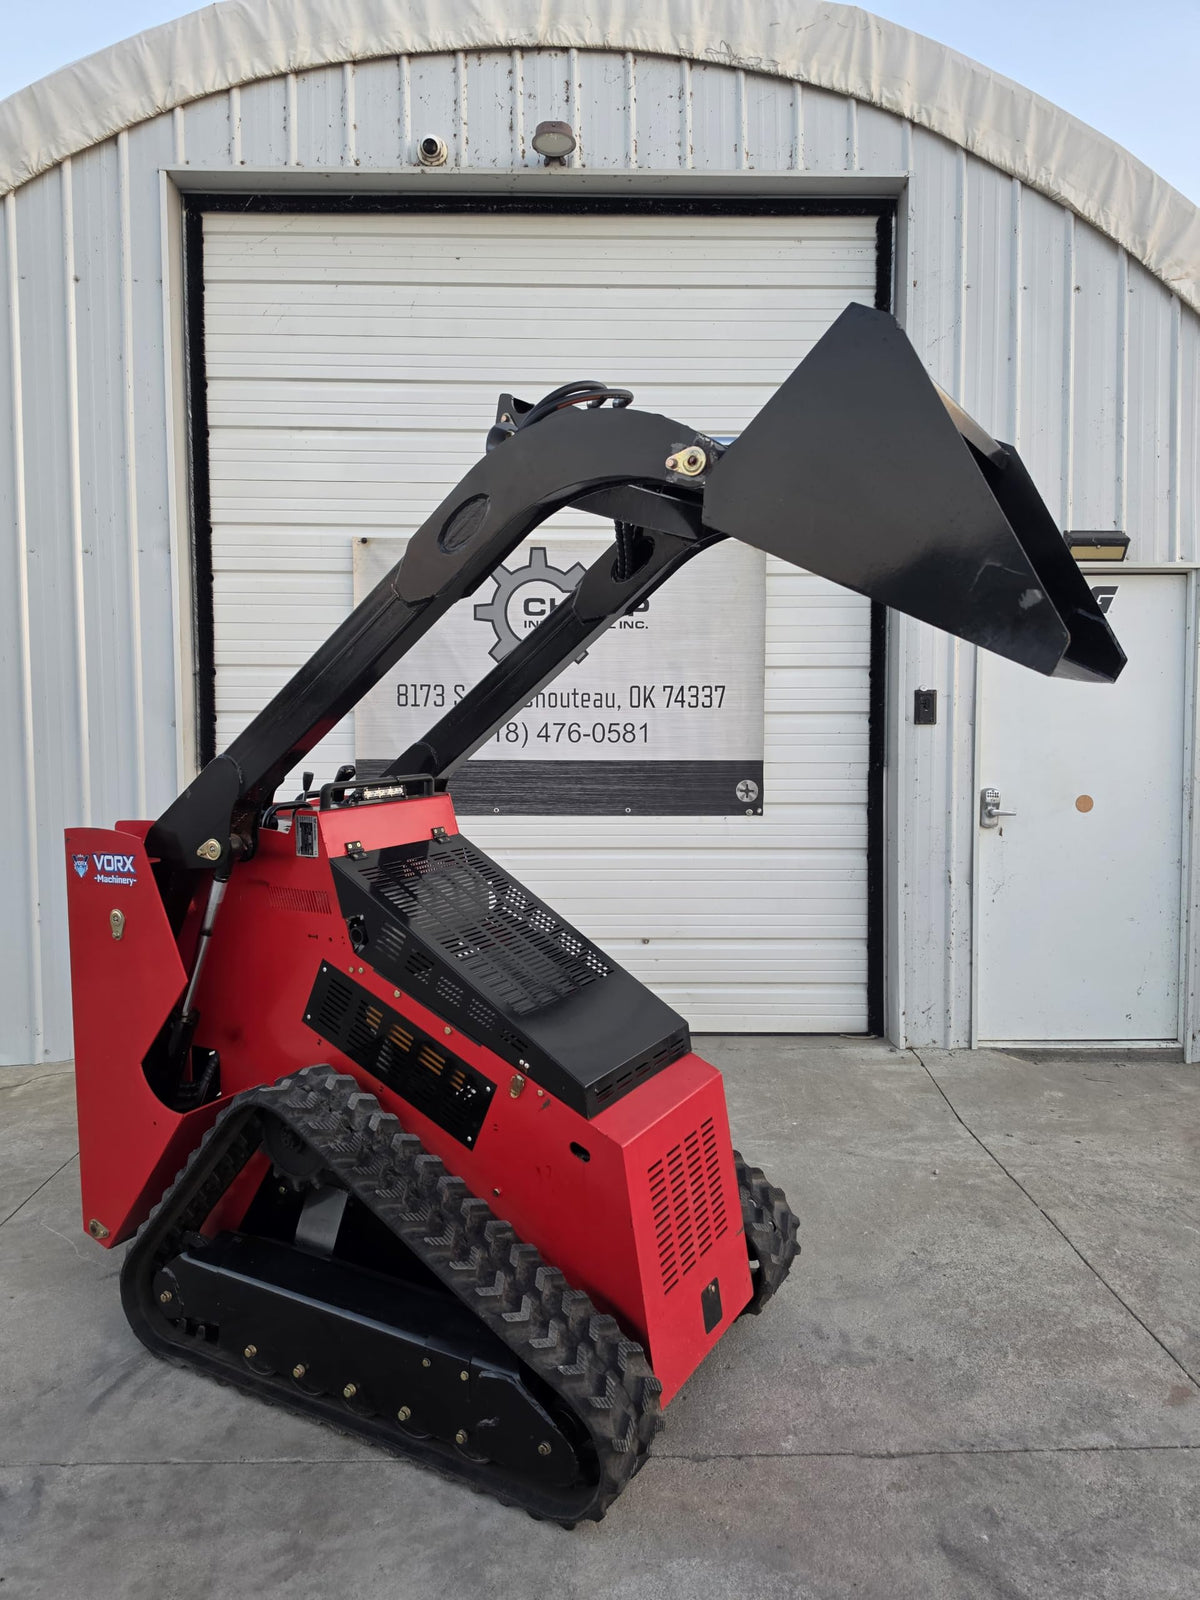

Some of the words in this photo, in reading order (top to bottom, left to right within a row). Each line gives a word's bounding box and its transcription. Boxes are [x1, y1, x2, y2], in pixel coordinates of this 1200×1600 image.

[619, 620, 649, 630] INC.
[396, 683, 445, 707] 8173
[523, 687, 622, 711] houteau,
[629, 685, 656, 709] OK
[662, 685, 726, 709] 74337
[536, 722, 648, 743] 476-0581
[92, 853, 135, 873] VORX
